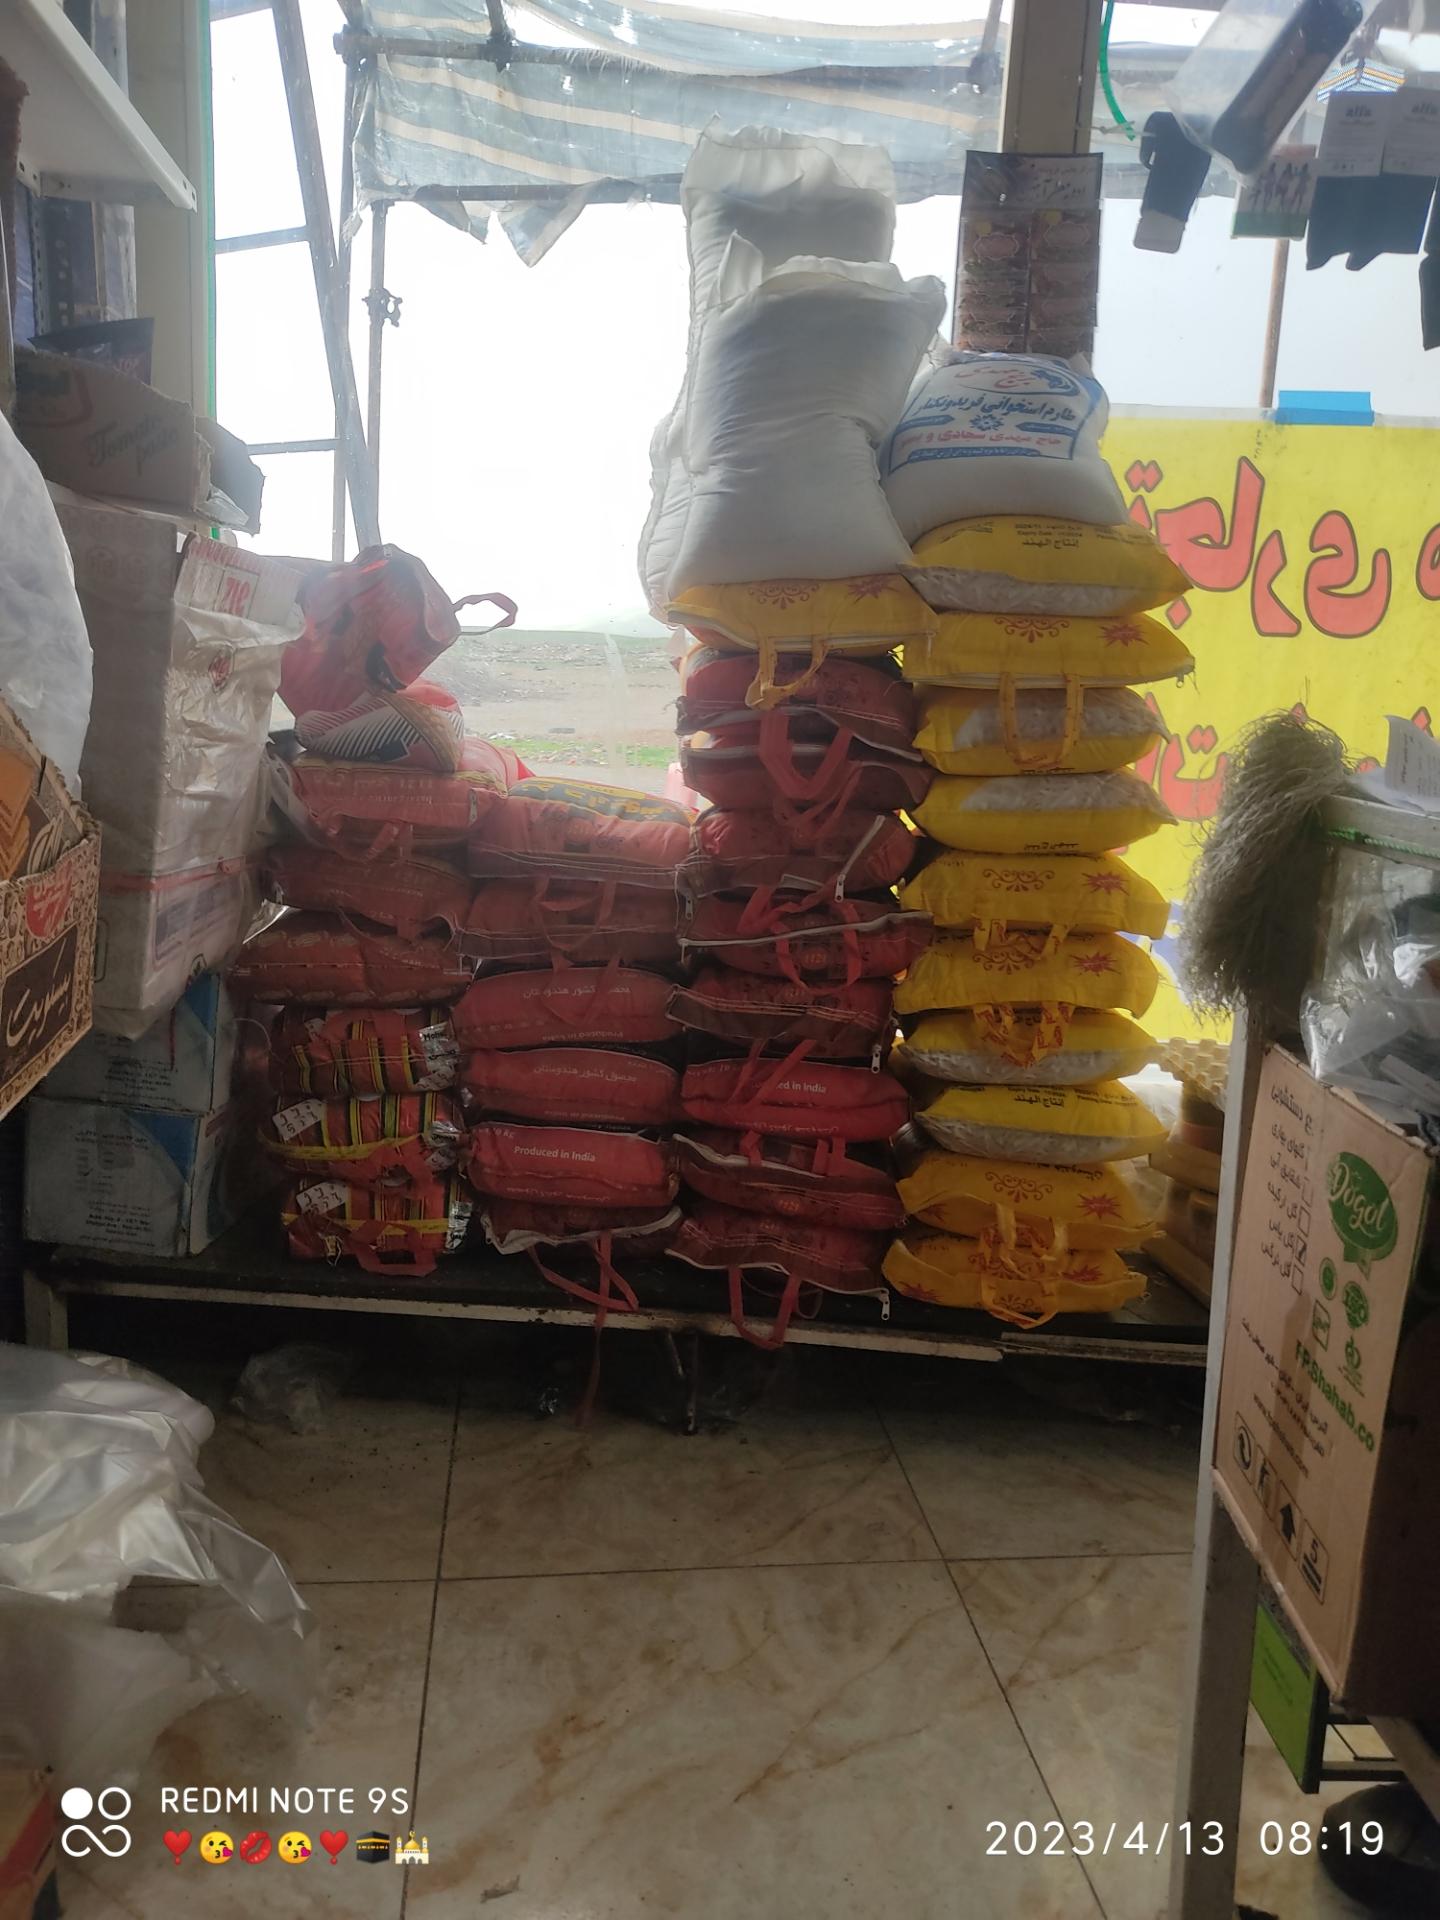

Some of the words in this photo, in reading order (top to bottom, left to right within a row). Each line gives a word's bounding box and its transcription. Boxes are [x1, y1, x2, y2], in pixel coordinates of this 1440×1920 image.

[803, 1081, 828, 1094] India
[513, 1145, 560, 1159] Produced
[560, 1149, 570, 1159] in
[571, 1150, 597, 1163] India
